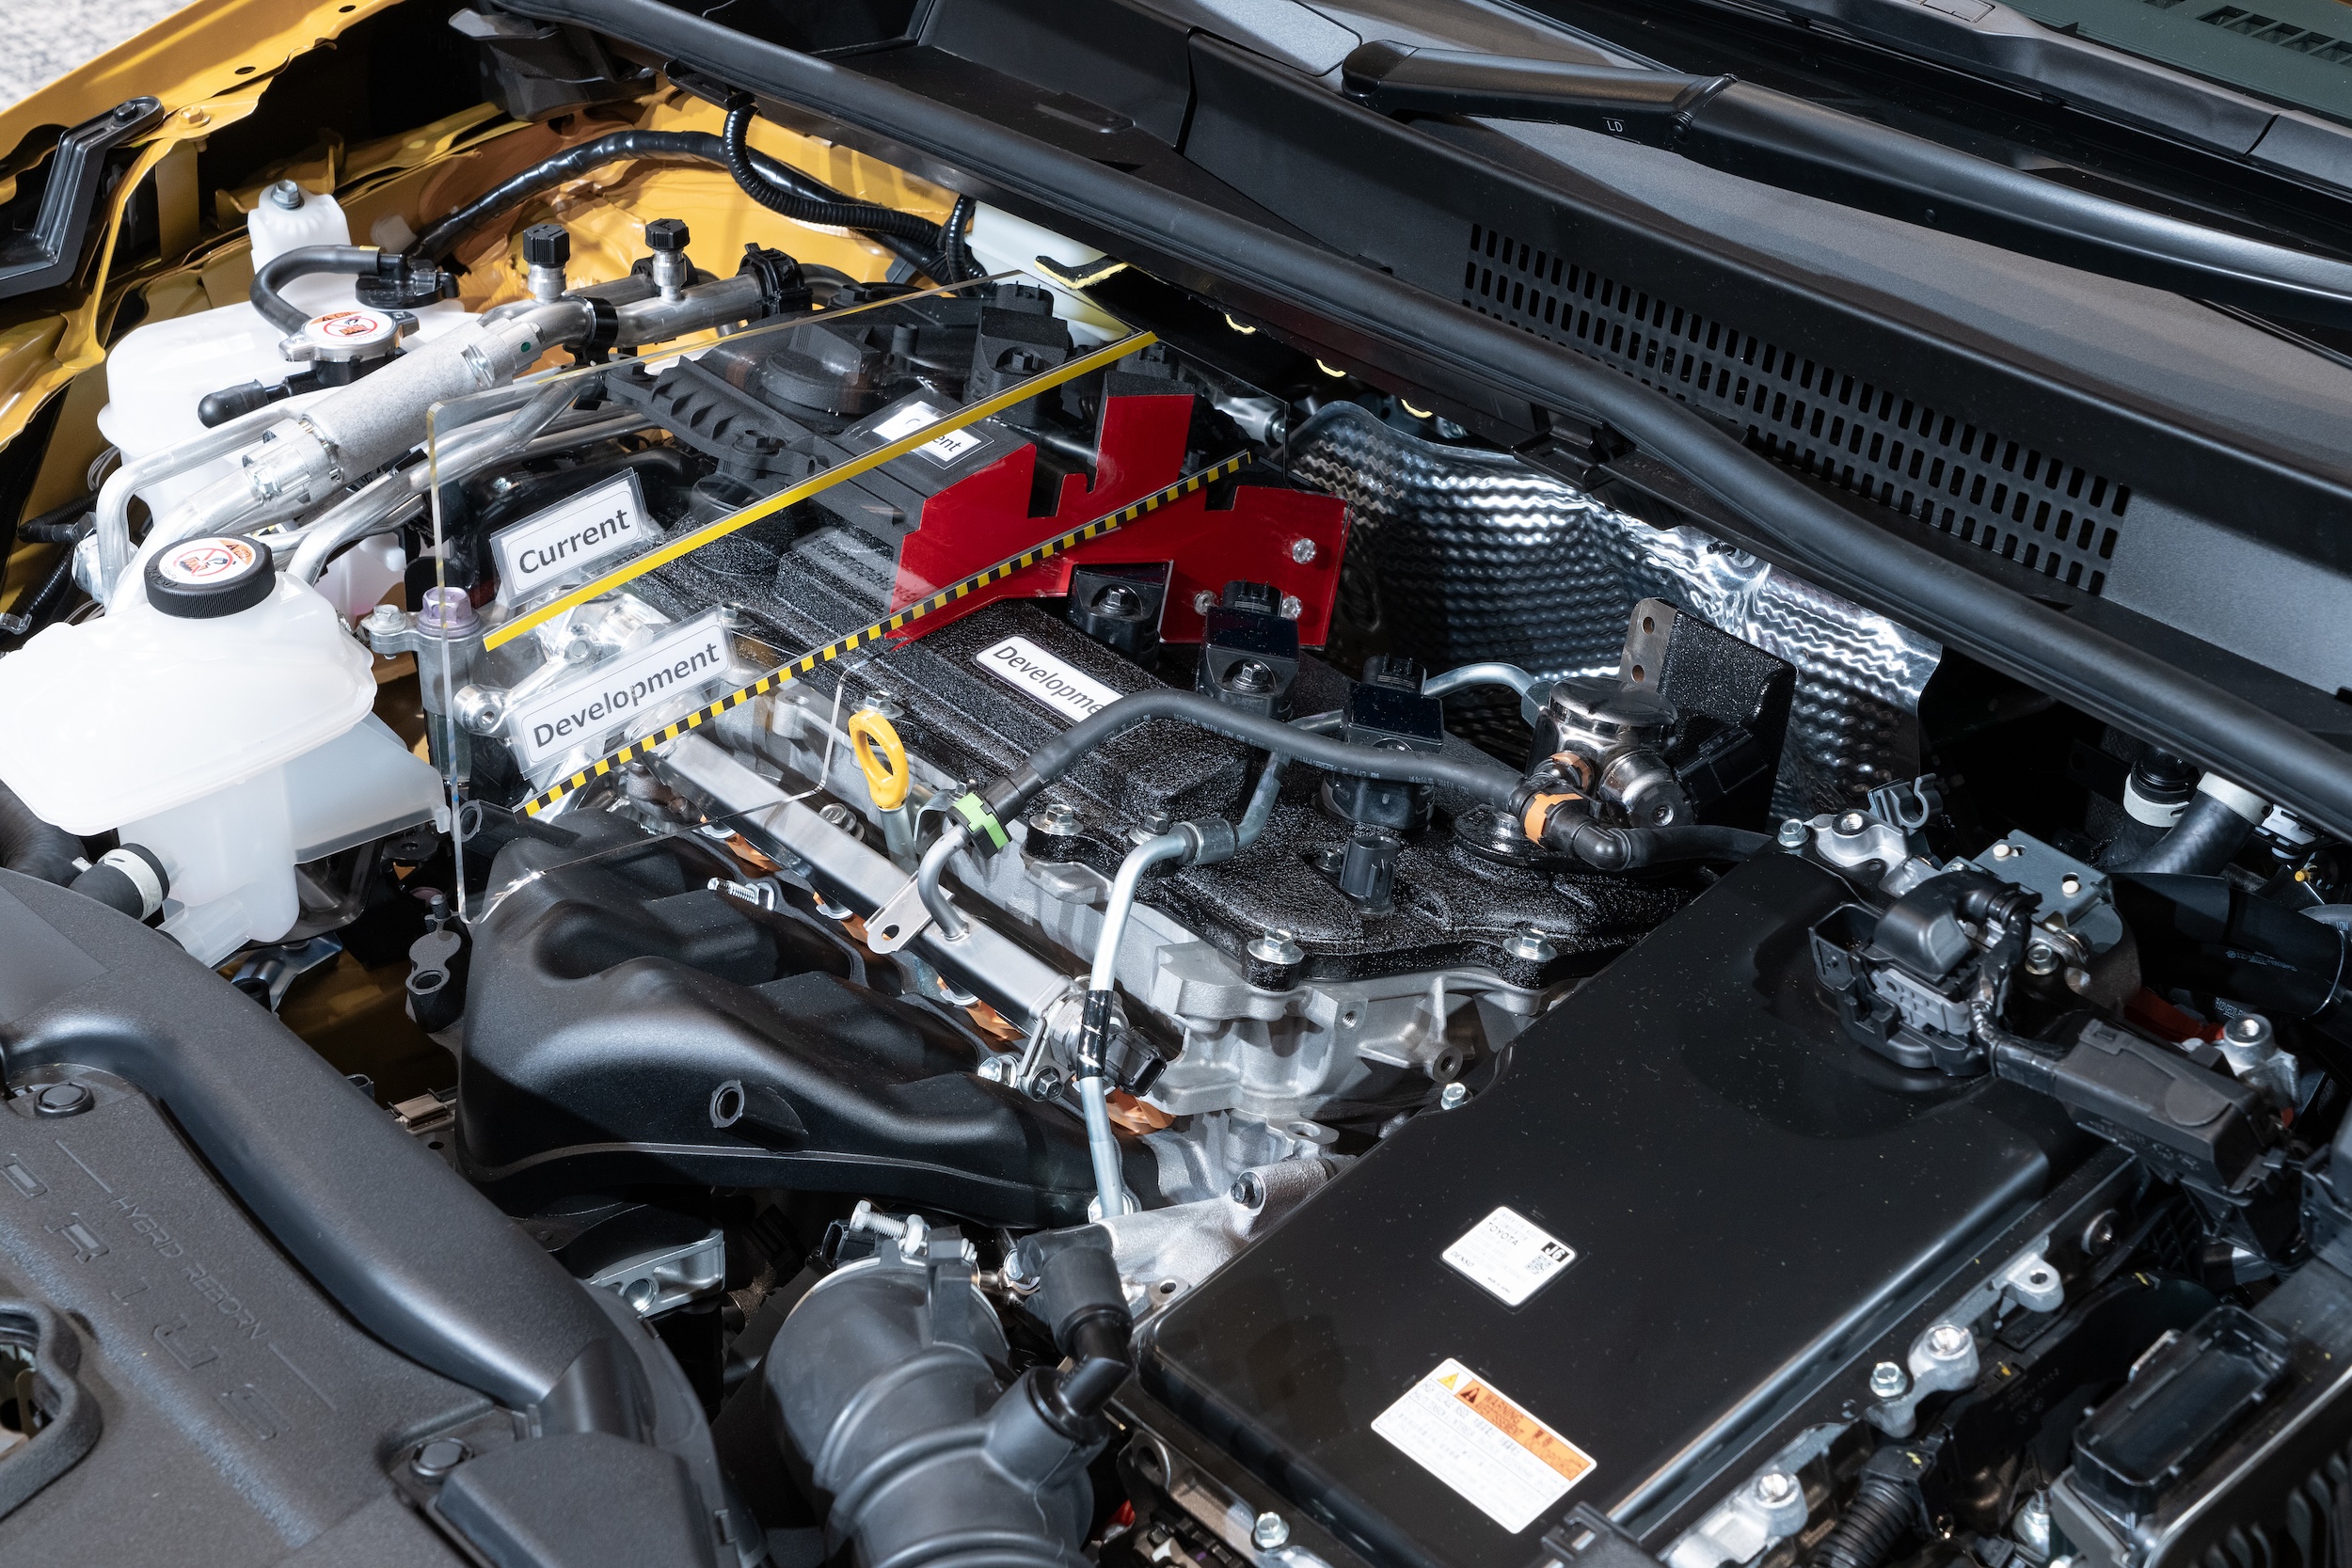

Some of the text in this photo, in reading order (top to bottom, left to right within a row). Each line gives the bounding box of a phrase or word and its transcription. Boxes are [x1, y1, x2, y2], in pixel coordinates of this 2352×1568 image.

[1606, 119, 1624, 133] LD
[905, 418, 962, 452] Cent
[518, 508, 631, 574] Current
[532, 642, 721, 748] Development
[993, 645, 1104, 716] Developme
[1483, 1221, 1520, 1247] TOYOTA
[1449, 1249, 1475, 1268] DENSO
[1543, 1243, 1566, 1260] J6
[109, 1196, 269, 1341] HYBRID REBORN
[1483, 1393, 1524, 1425] WARNING
